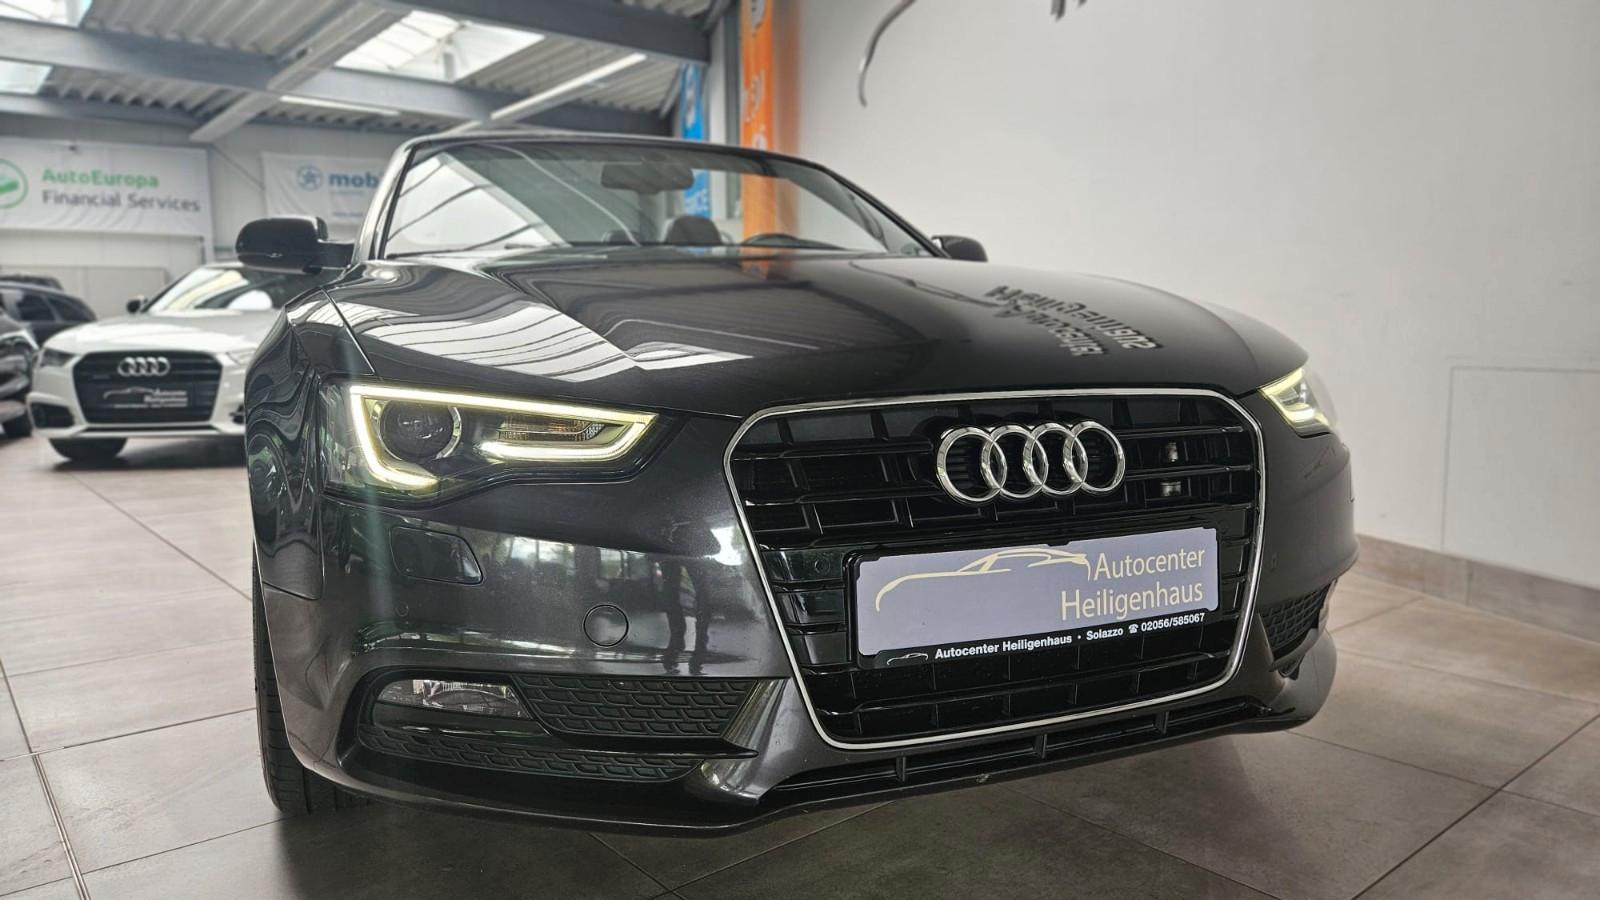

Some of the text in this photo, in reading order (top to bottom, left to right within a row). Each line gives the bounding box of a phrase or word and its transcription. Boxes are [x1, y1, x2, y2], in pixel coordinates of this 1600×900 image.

[41, 168, 160, 188] AutoEuropa
[329, 171, 383, 188] mob
[42, 190, 200, 212] Financial Services
[1093, 548, 1205, 581] Autocenter
[1061, 581, 1204, 621] Heiligenhaus
[934, 612, 1206, 660] Autocenter Heiligenhaus Solazzo 02056/585067
